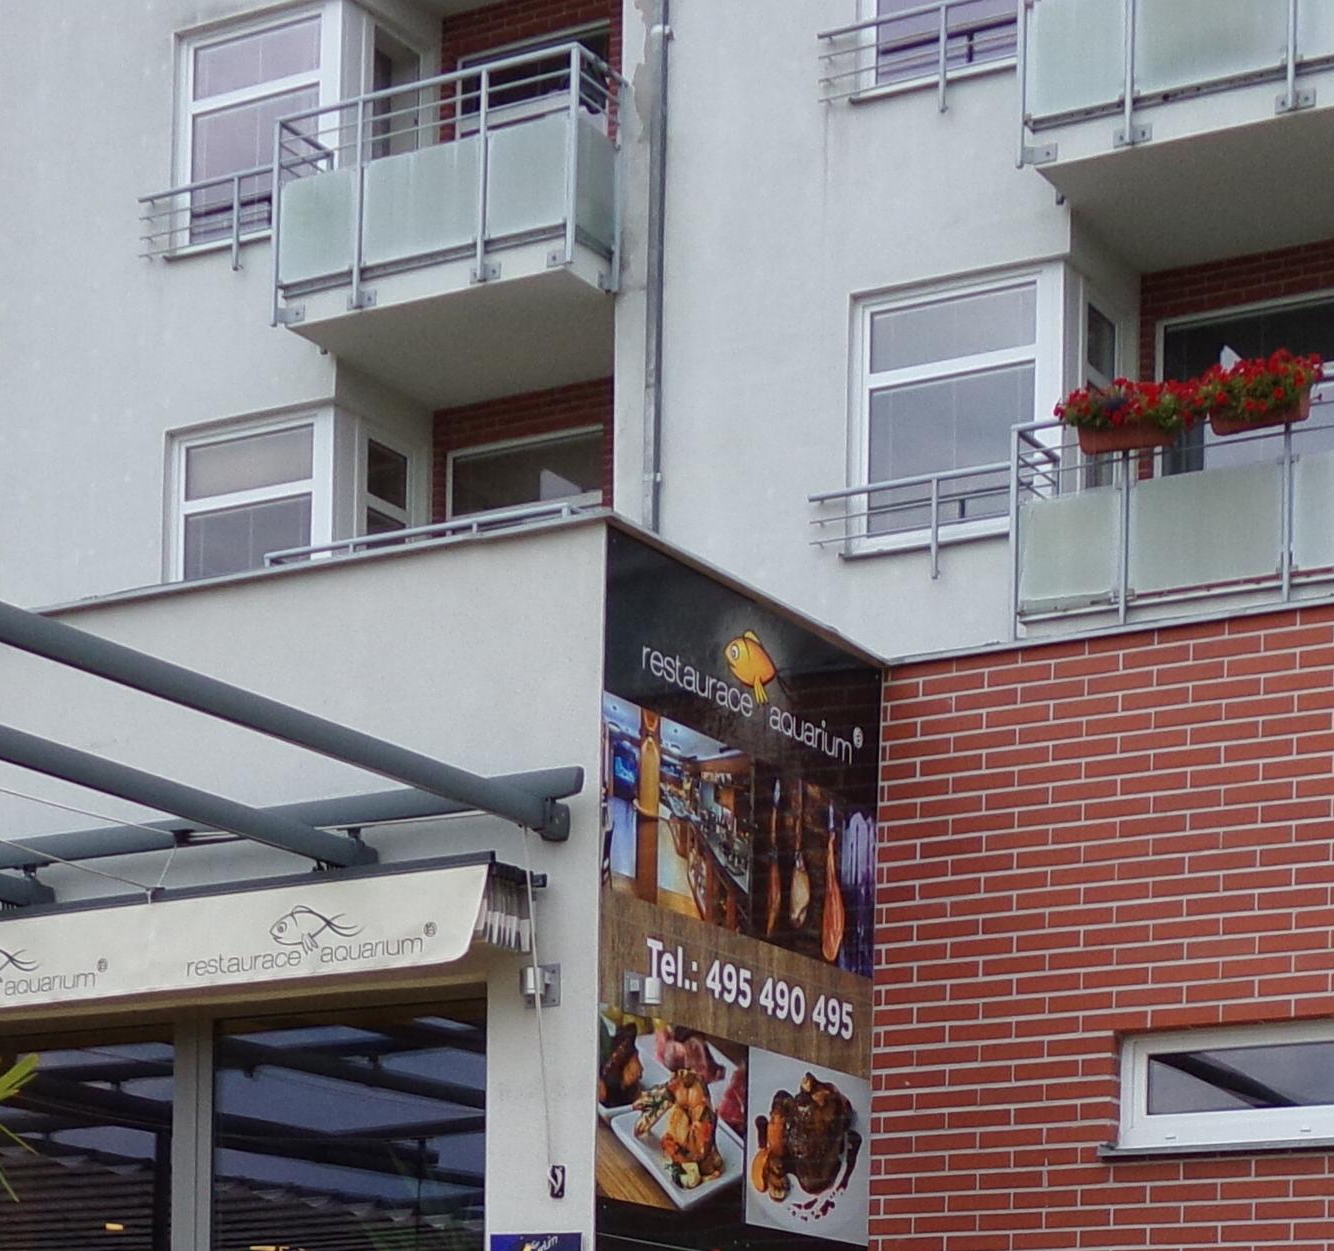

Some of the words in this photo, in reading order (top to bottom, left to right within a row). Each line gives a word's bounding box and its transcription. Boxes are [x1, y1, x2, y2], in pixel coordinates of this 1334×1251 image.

[642, 643, 754, 719] restaurace
[186, 947, 301, 977] restaurace
[646, 938, 700, 993] Tel.:
[705, 959, 753, 1009] 495
[759, 975, 806, 1025] 490
[813, 994, 855, 1041] 495
